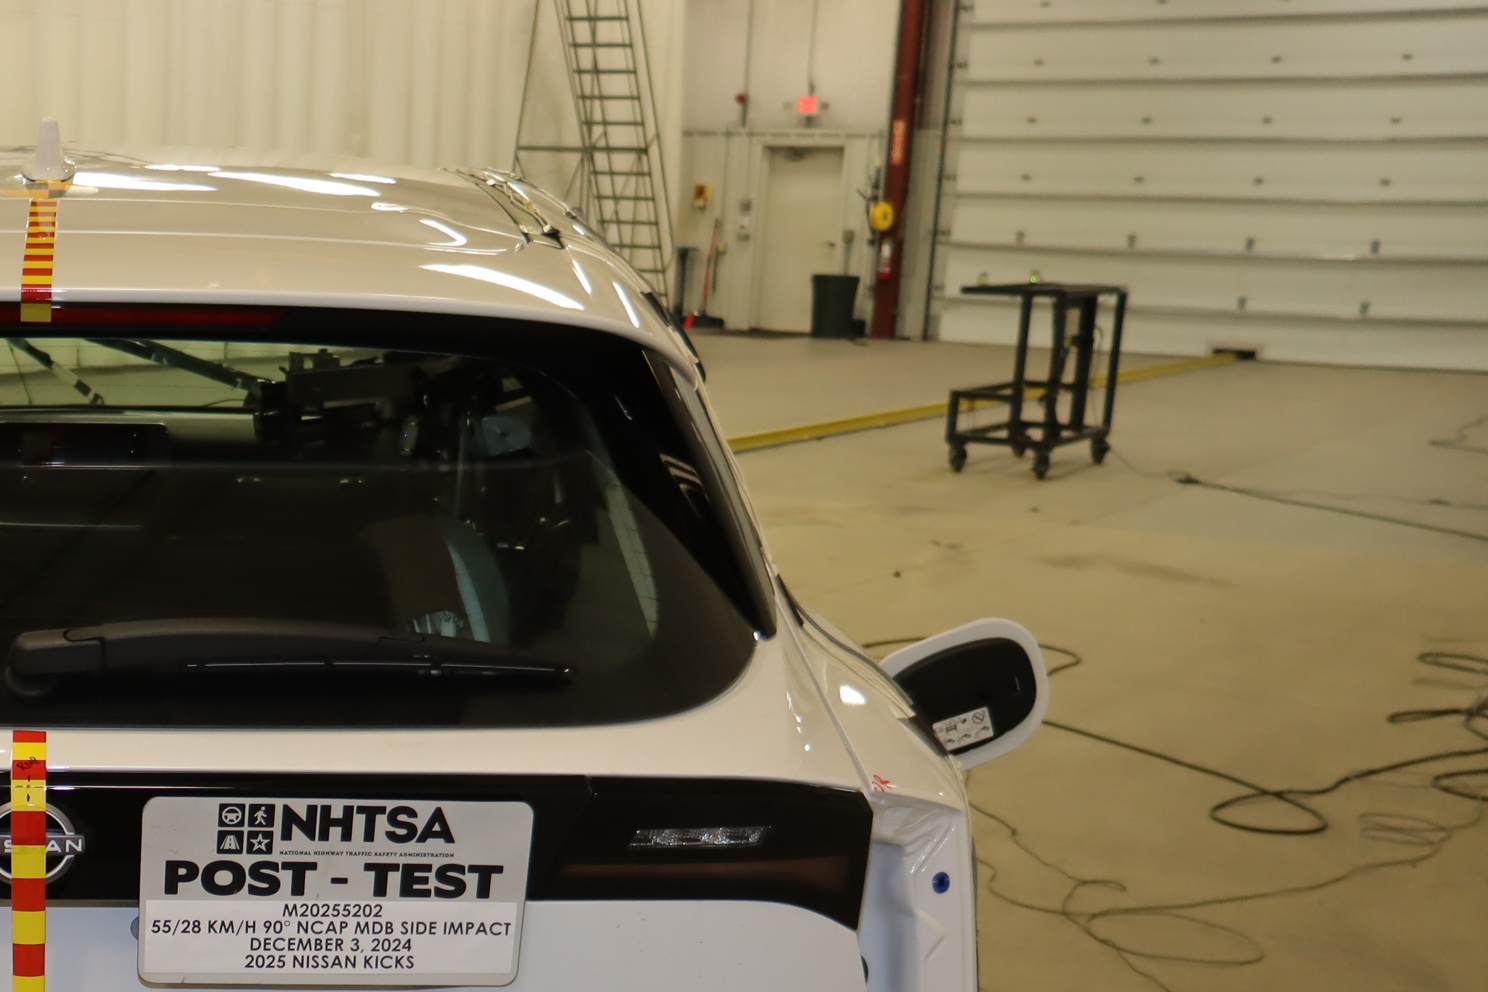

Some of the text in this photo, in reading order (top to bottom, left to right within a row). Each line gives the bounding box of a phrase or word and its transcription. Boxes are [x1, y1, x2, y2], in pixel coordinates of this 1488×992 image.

[280, 804, 456, 844] NHTSA
[164, 860, 318, 897] POST
[363, 862, 504, 900] TEST
[282, 903, 383, 918] M20255202
[150, 920, 512, 937] 55/28 KM/H 90° NCAP MDB SIDE IMPACT
[249, 937, 412, 954] DECEMBER 3, 2024
[244, 954, 415, 970] 2025 NISSAN KICKS
